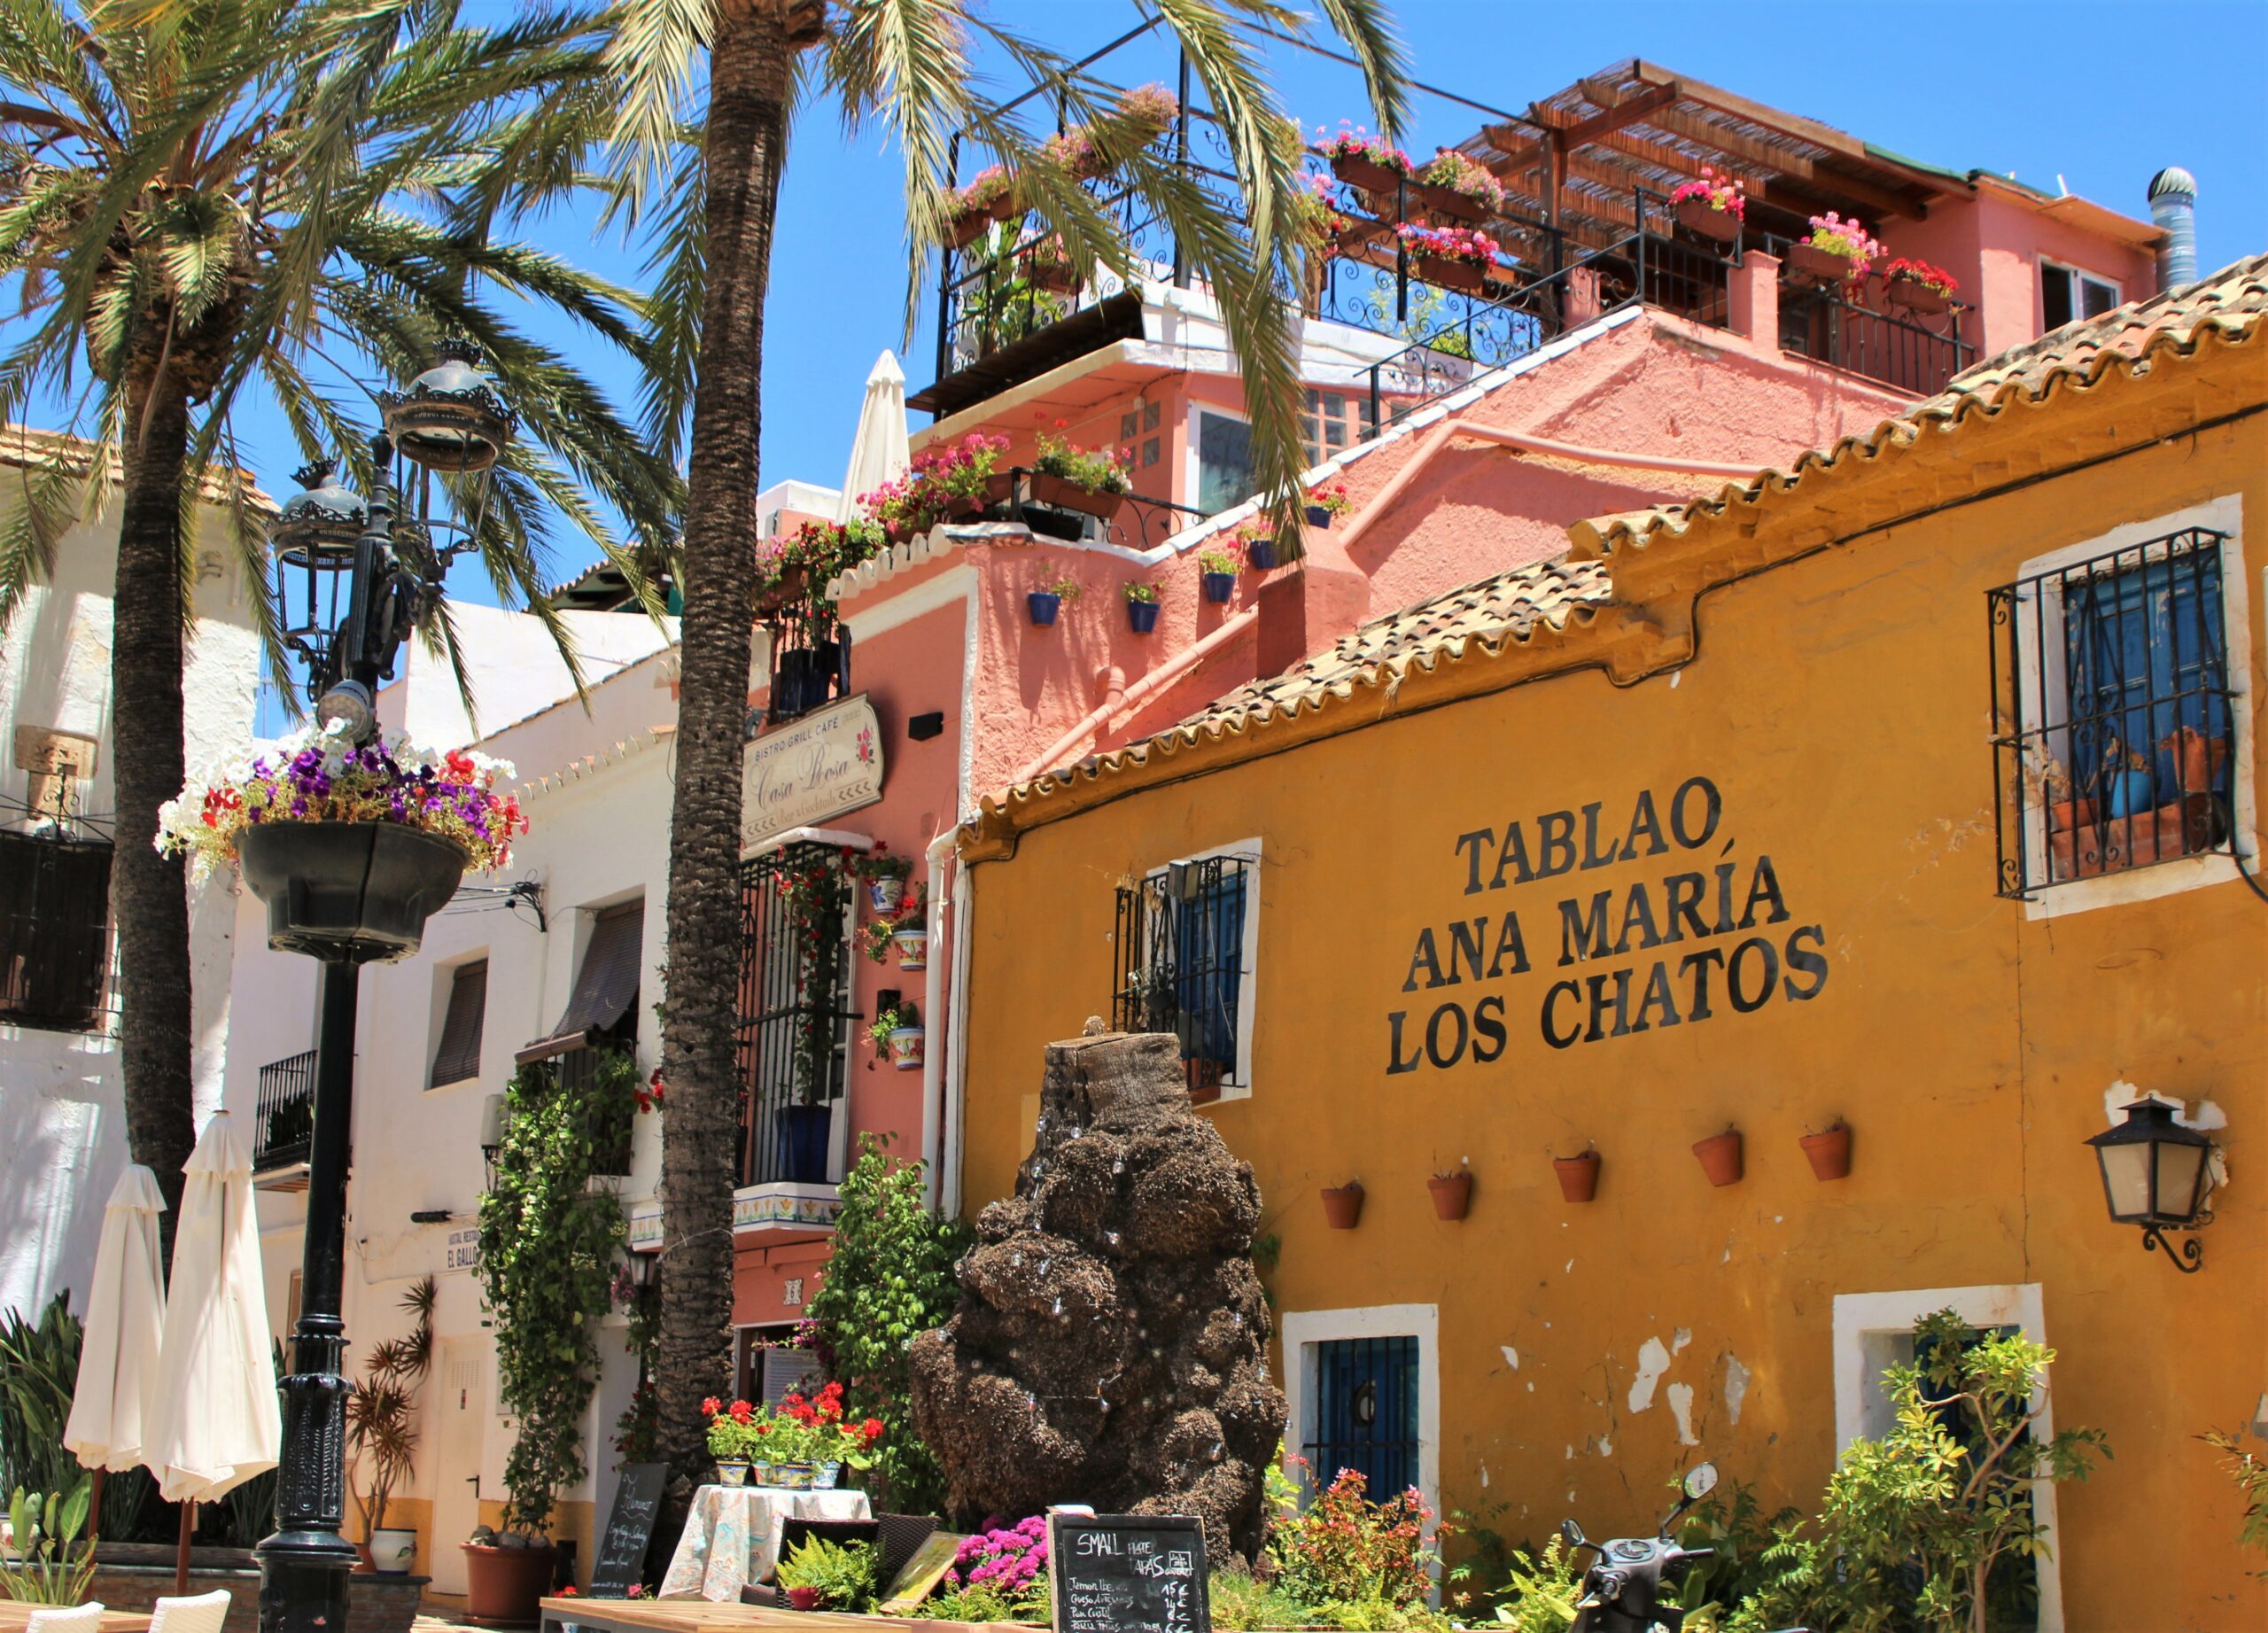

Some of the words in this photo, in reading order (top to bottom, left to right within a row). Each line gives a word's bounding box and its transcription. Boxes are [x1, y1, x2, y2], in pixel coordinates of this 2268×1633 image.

[755, 740, 785, 762] BISTRO
[788, 729, 813, 749] GRILL
[815, 717, 839, 736] CAFÉ
[749, 762, 794, 814] Casa
[797, 742, 850, 791] Rosa
[1456, 776, 1722, 895] TABLAO
[1402, 912, 1531, 992] ANA
[1558, 837, 1790, 967] MARÍA
[1386, 995, 1508, 1075] LOS
[1541, 926, 1829, 1050] CHATOS
[448, 1249, 454, 1268] EL
[789, 1286, 796, 1299] 6
[1076, 1533, 1125, 1557] SMALL
[1130, 1555, 1164, 1577] TAPAS
